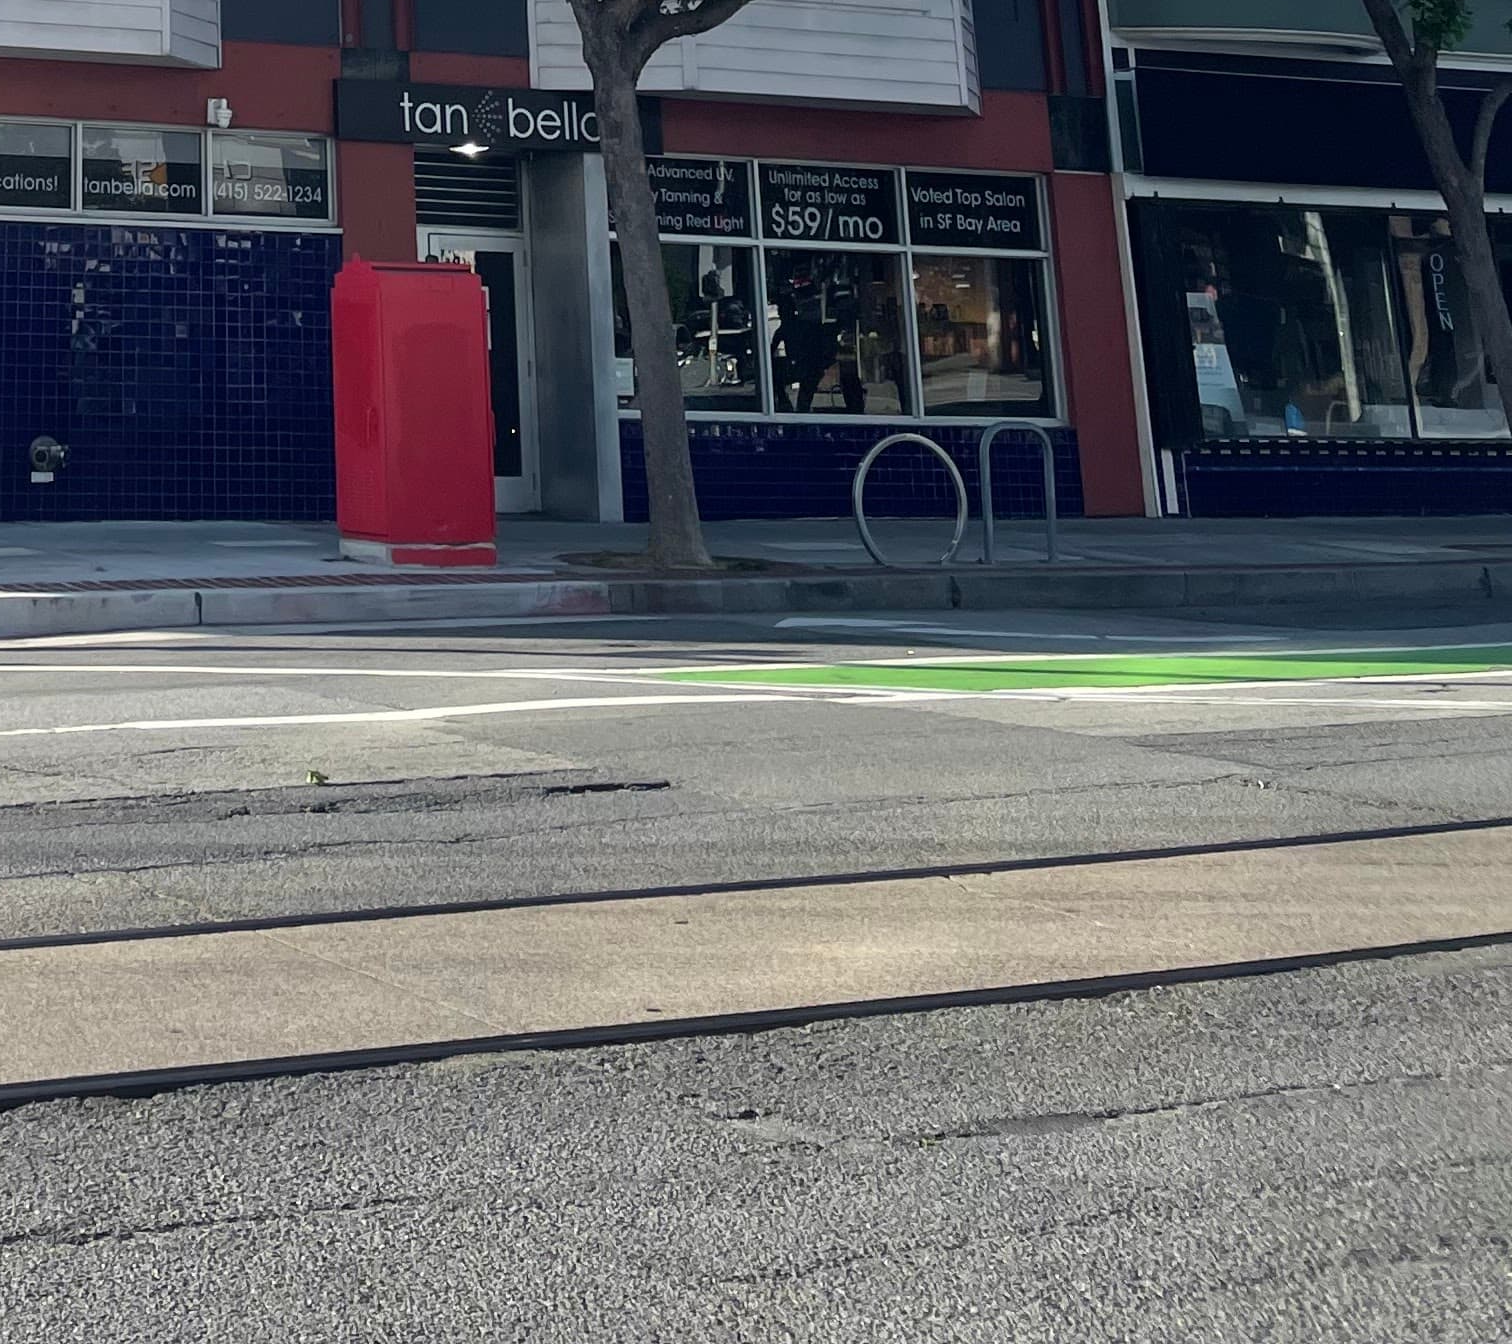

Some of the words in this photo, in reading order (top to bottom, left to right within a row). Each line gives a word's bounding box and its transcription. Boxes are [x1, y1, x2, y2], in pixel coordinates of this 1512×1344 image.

[400, 92, 469, 135] tan
[648, 164, 713, 180] Advanced
[769, 170, 829, 187] Unlimited
[833, 174, 879, 189] Access
[83, 176, 196, 198] tanbella.com
[213, 180, 248, 201] (415)
[254, 183, 322, 204] 522-1234
[784, 187, 801, 202] for
[806, 191, 822, 203] as
[824, 189, 848, 204] low
[851, 193, 866, 206] as
[911, 186, 953, 204] Voted
[954, 188, 982, 208] Top
[985, 190, 1025, 208] Salon
[660, 189, 710, 208] Tanning
[713, 192, 724, 205] &
[686, 214, 711, 228] Red
[714, 215, 745, 232] Light
[920, 213, 934, 229] in
[937, 213, 953, 229] SF
[956, 214, 983, 234] Bay
[987, 216, 1021, 232] Area
[1430, 253, 1454, 330] OPEN
